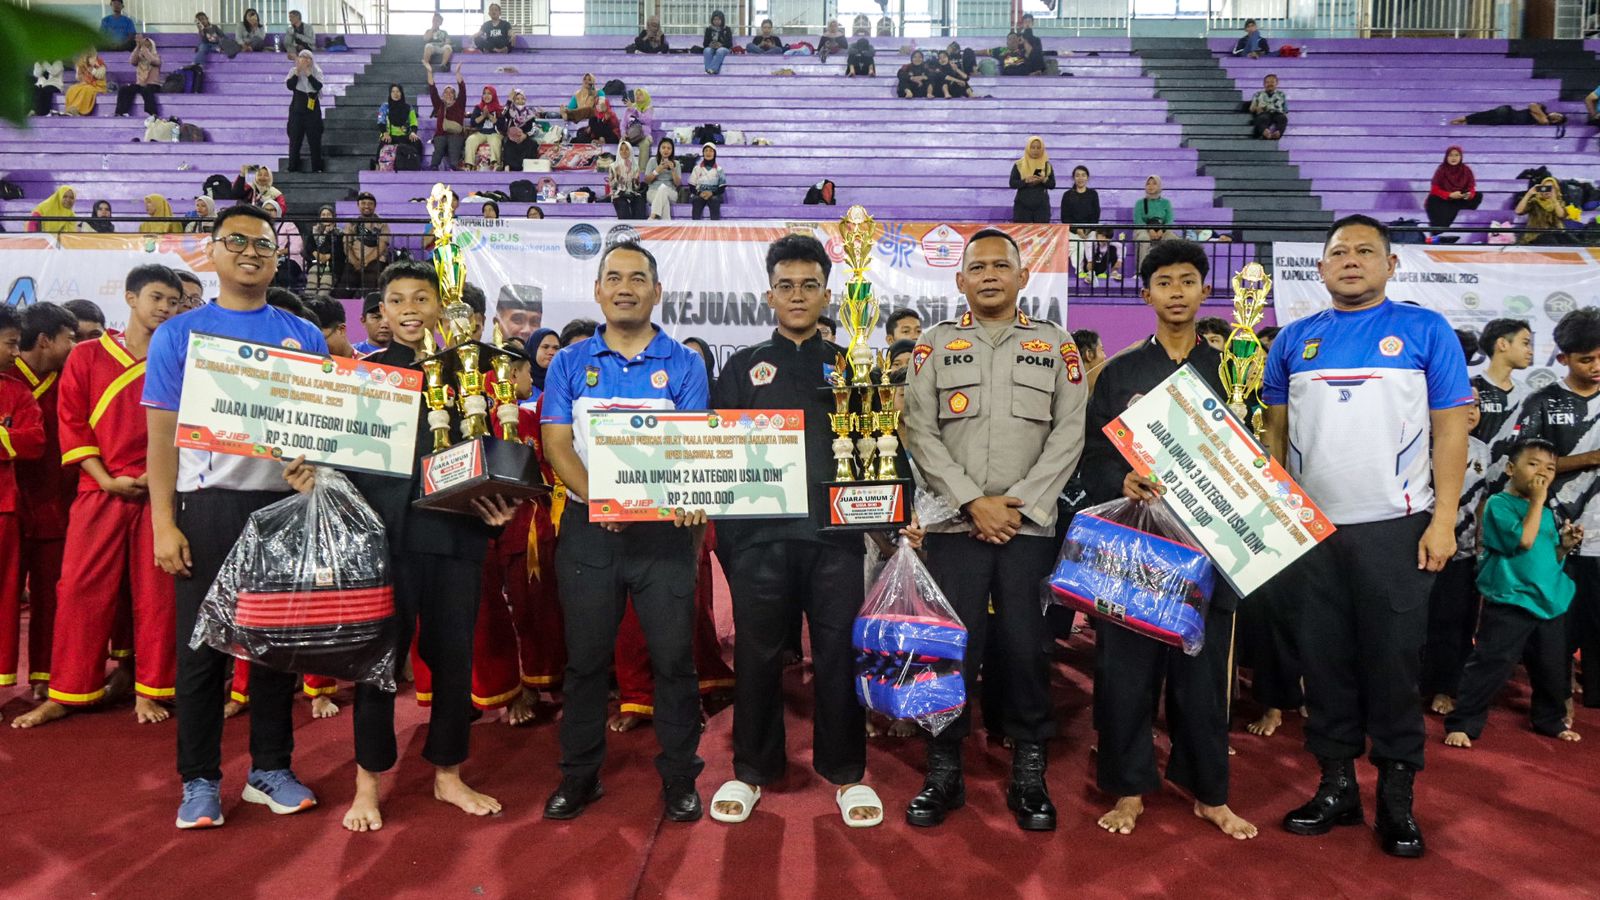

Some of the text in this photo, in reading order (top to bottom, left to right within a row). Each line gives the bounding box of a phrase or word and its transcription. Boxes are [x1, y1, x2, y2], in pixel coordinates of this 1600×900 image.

[490, 233, 519, 242] BPJS
[1458, 273, 1479, 284] 2025
[662, 291, 779, 326] KEJUARA
[944, 354, 974, 366] EKO
[1017, 355, 1054, 369] POLRI
[210, 398, 391, 439] JUARA UMUM 1 KATEGORI USIA DINI
[1547, 413, 1575, 425] KEN
[265, 429, 337, 453] RP 3.000.000
[615, 467, 782, 485] JUARA UMUM 2 KATEGORI USIA DINI
[1147, 420, 1266, 555] JUARA UMUM 3 KATEGORI USIA DINI
[668, 490, 734, 505] RP 2.000.000
[1162, 470, 1213, 527] RP 1.000.000
